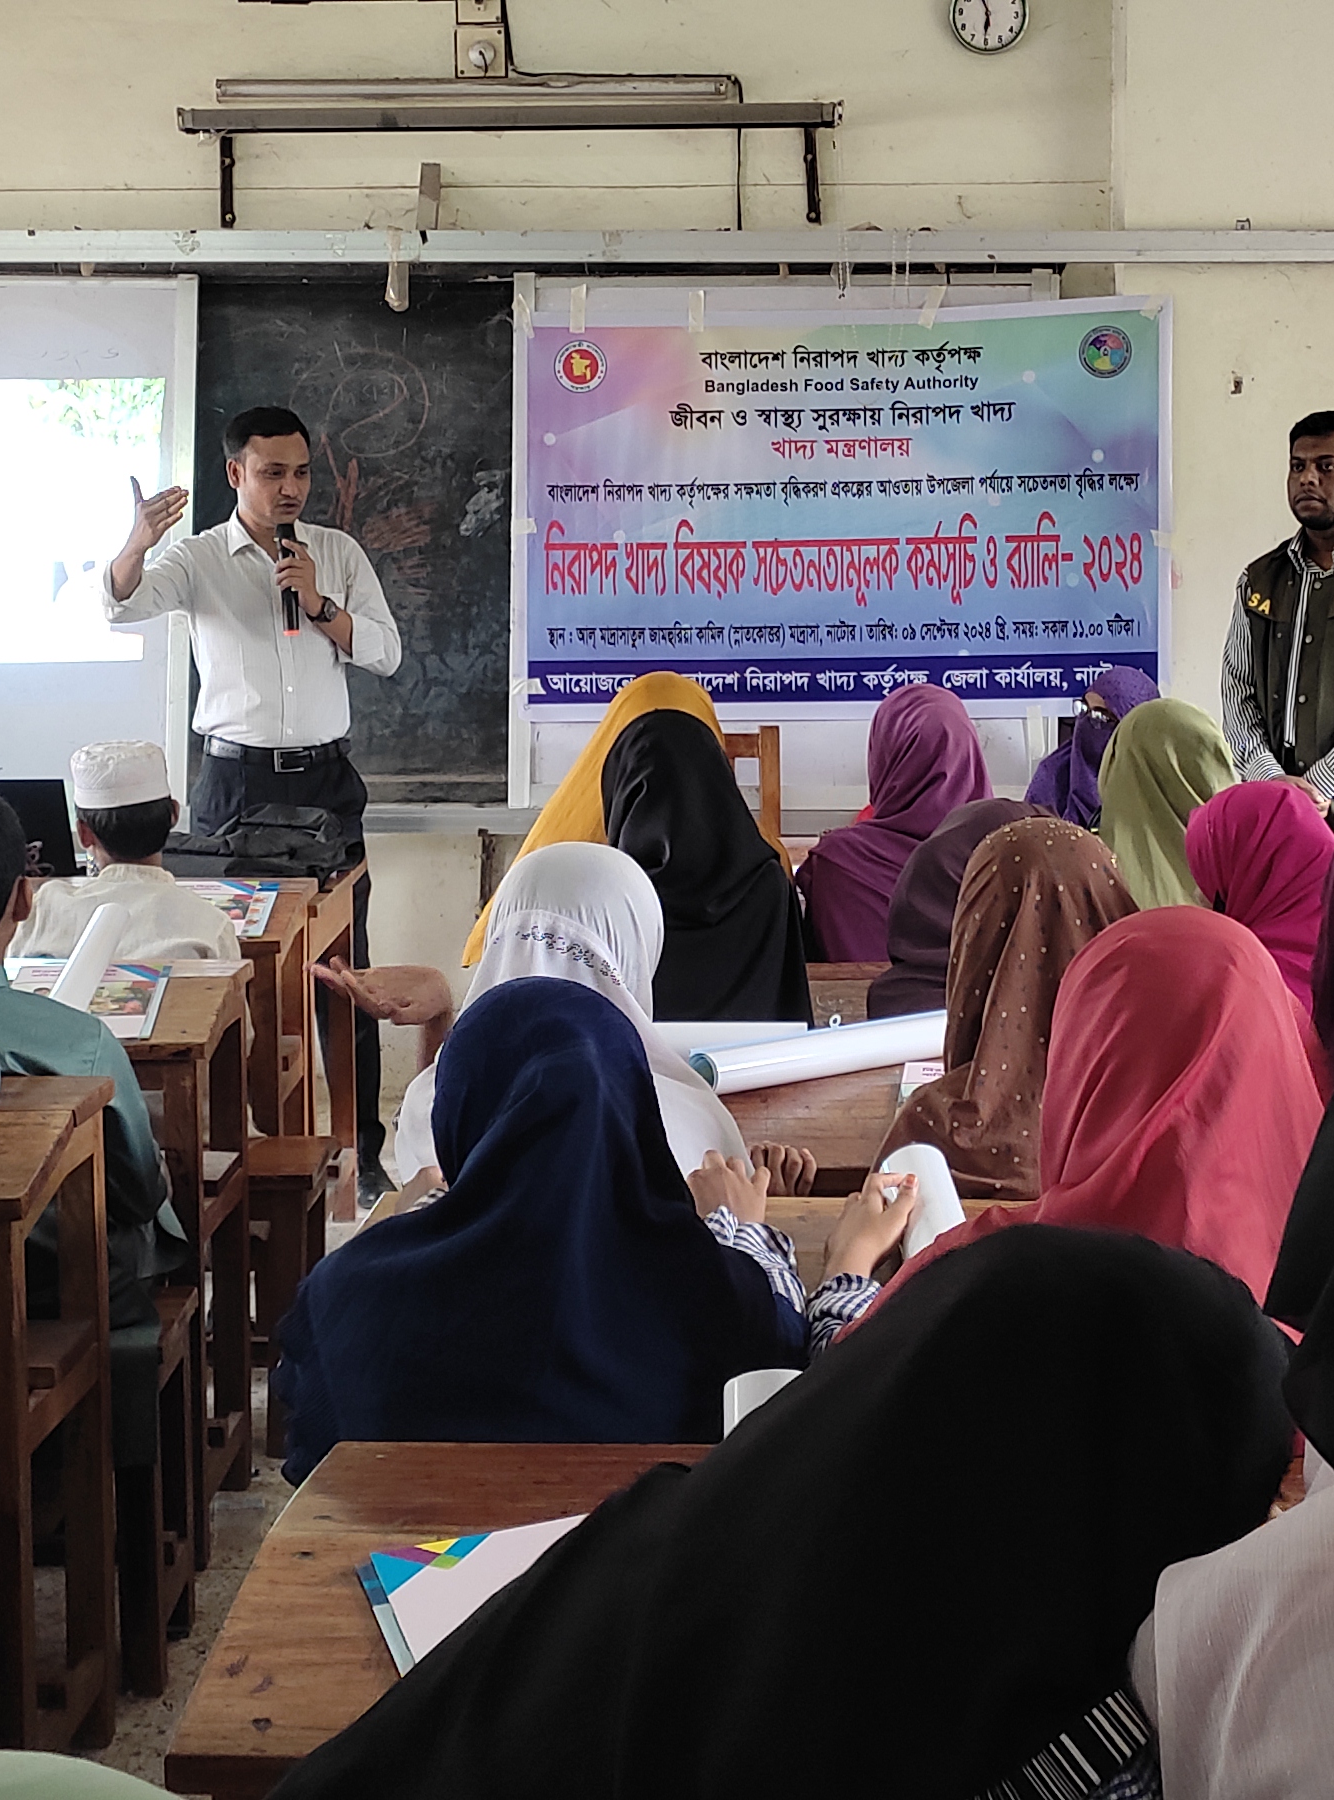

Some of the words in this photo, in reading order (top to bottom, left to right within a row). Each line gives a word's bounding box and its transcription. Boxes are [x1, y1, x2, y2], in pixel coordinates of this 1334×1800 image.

[958, 8, 963, 16] 9
[1014, 11, 1019, 19] 3
[961, 23, 966, 31] 8
[998, 35, 1003, 43] 5
[983, 38, 988, 46] 6
[699, 350, 787, 370] বাংলাদেশ
[792, 345, 859, 369] নিরাপদ
[866, 348, 909, 368] খাদ্য
[912, 341, 983, 374] কর্তৃপক্ষ
[705, 379, 798, 395] Bangladesh
[805, 378, 844, 392] Food
[850, 377, 899, 393] Safety
[904, 375, 979, 390] Authority
[668, 403, 725, 430] জীবন
[731, 410, 747, 426] ও
[755, 407, 805, 433] স্বাস্থ্য
[810, 405, 884, 433] সুরক্ষায়
[889, 400, 964, 426] নিরাপদ
[970, 401, 1017, 422] খাদ্য
[771, 437, 818, 460] খাদ্য
[823, 436, 913, 459] মন্ত্রণালয়
[546, 482, 600, 504] বাংলাদেশ
[603, 478, 644, 502] নিরাপদ
[647, 482, 673, 502] খাদ্য
[675, 477, 731, 509] কর্তৃপক্ষের
[733, 480, 777, 500] সক্ষমতা
[779, 475, 827, 507] বৃদ্ধিকরণ
[831, 479, 874, 499] প্রকল্পের
[876, 478, 923, 498] আওতায়
[926, 473, 974, 495] উপজেলা
[979, 469, 1014, 494] পর্যায়ে
[1017, 473, 1071, 494] সচেতনতা
[1074, 467, 1105, 500] বৃদ্ধির
[1108, 472, 1140, 492] লক্ষ্যে
[544, 520, 618, 595] নিরাপদ
[624, 542, 667, 596] খাদ্য
[673, 519, 746, 600] বিষয়ক
[752, 537, 900, 607] সচেতনতামূলক
[906, 513, 977, 606] কর্মসূচি
[982, 535, 997, 588] ও
[1083, 533, 1142, 592] ২০২৪
[546, 626, 566, 649] স্থান
[695, 620, 725, 644] কামিল
[963, 621, 992, 642] ২০২৪
[1042, 619, 1069, 640] সকাল
[744, 666, 811, 692] নিরাপদ
[816, 670, 857, 692] খাদ্য
[942, 667, 989, 689] জেলা
[992, 661, 1068, 692] কার্যালয়,
